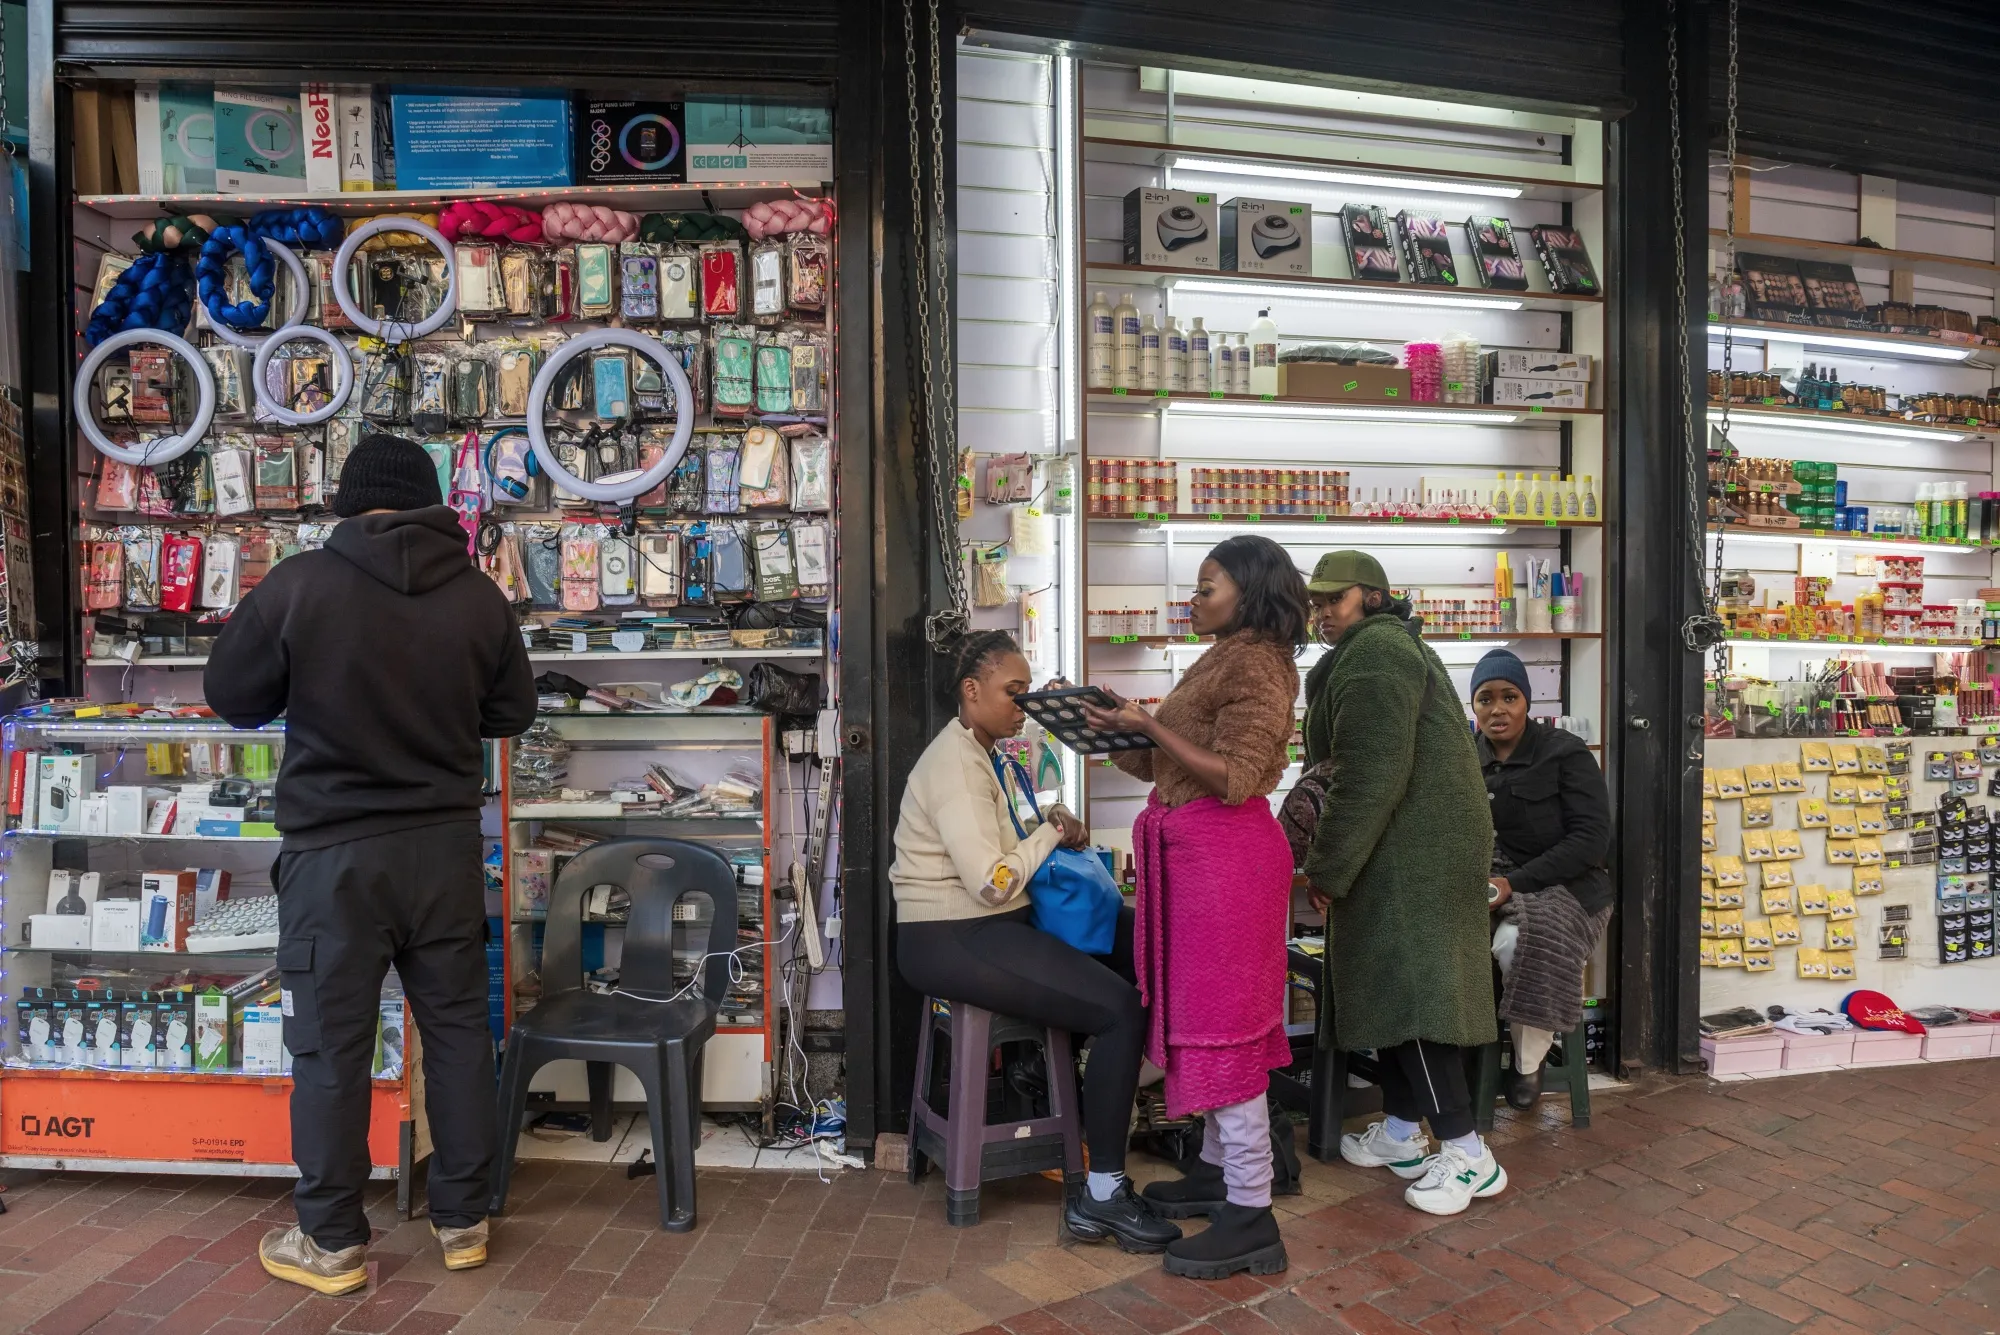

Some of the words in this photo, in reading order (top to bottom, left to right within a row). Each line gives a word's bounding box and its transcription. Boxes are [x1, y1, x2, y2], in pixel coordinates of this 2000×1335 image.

[1144, 193, 1170, 202] 2-in-1
[1241, 202, 1265, 211] 2-in-1
[44, 1116, 95, 1138] AGT
